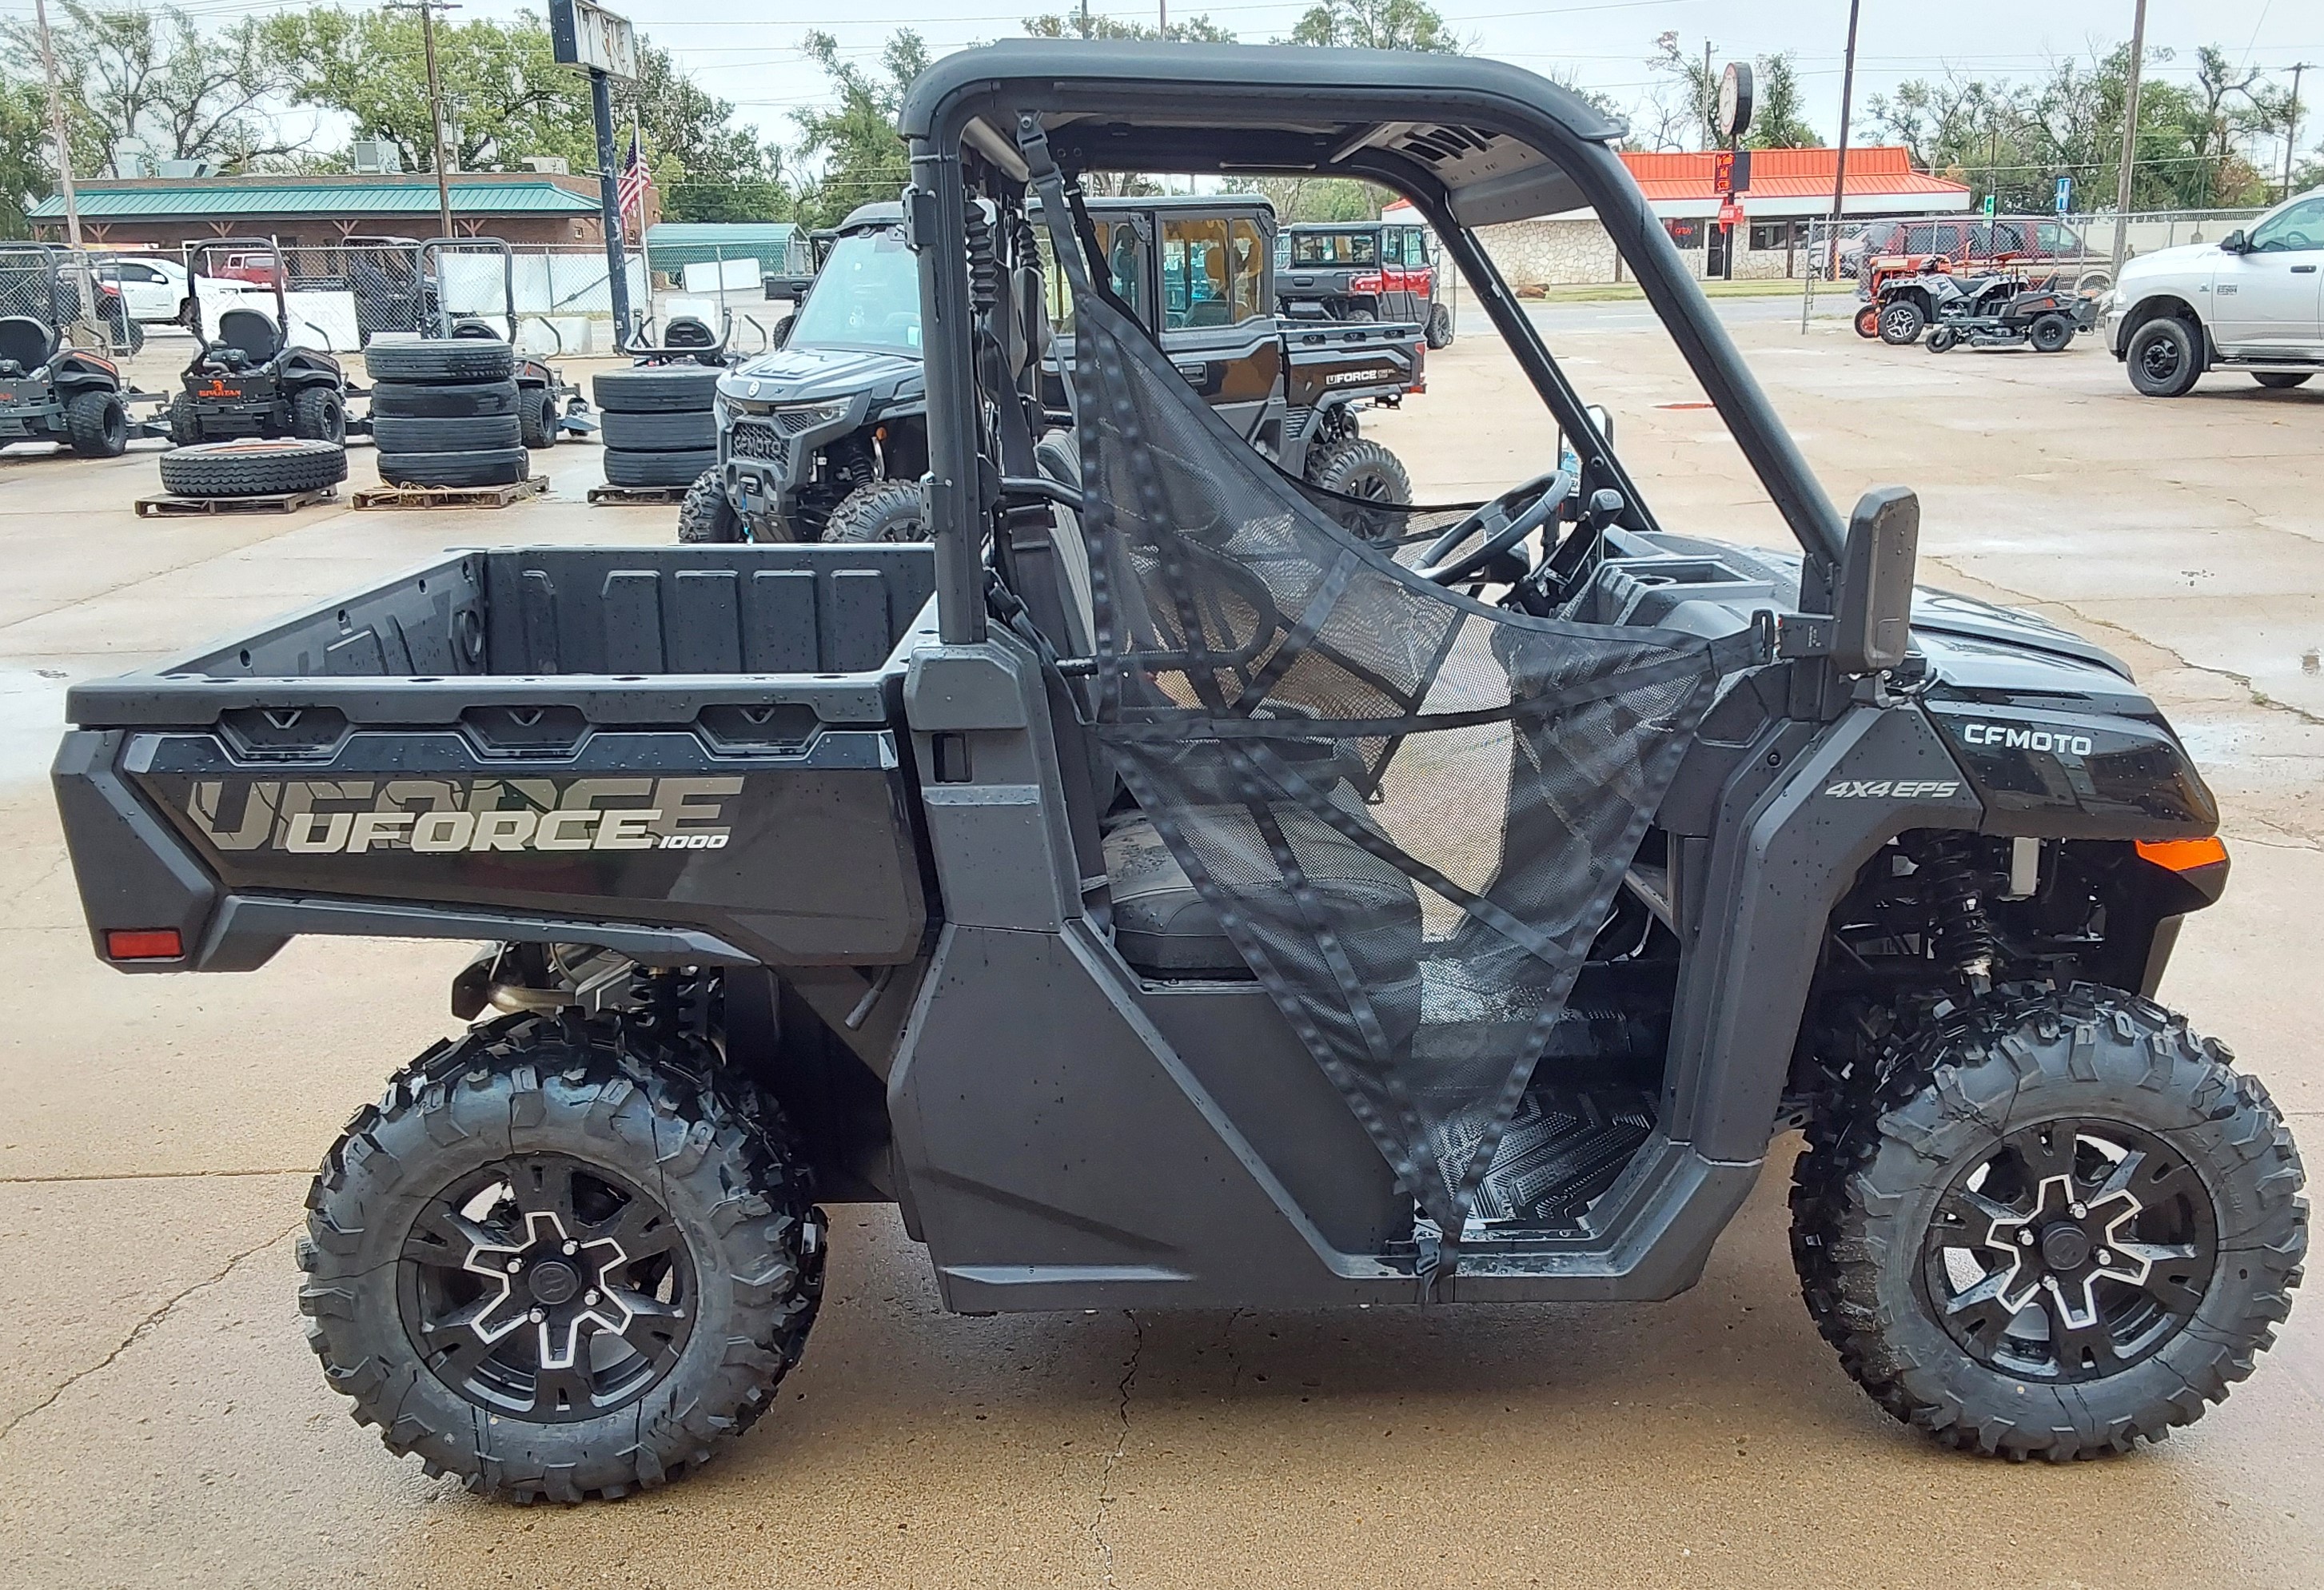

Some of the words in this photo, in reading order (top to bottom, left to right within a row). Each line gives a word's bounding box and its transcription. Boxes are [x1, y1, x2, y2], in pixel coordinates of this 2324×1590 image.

[1326, 370, 1377, 385] UFORCE
[1964, 723, 2092, 755] CFMOTO
[285, 810, 663, 853] UFORCE
[658, 835, 729, 849] 1000
